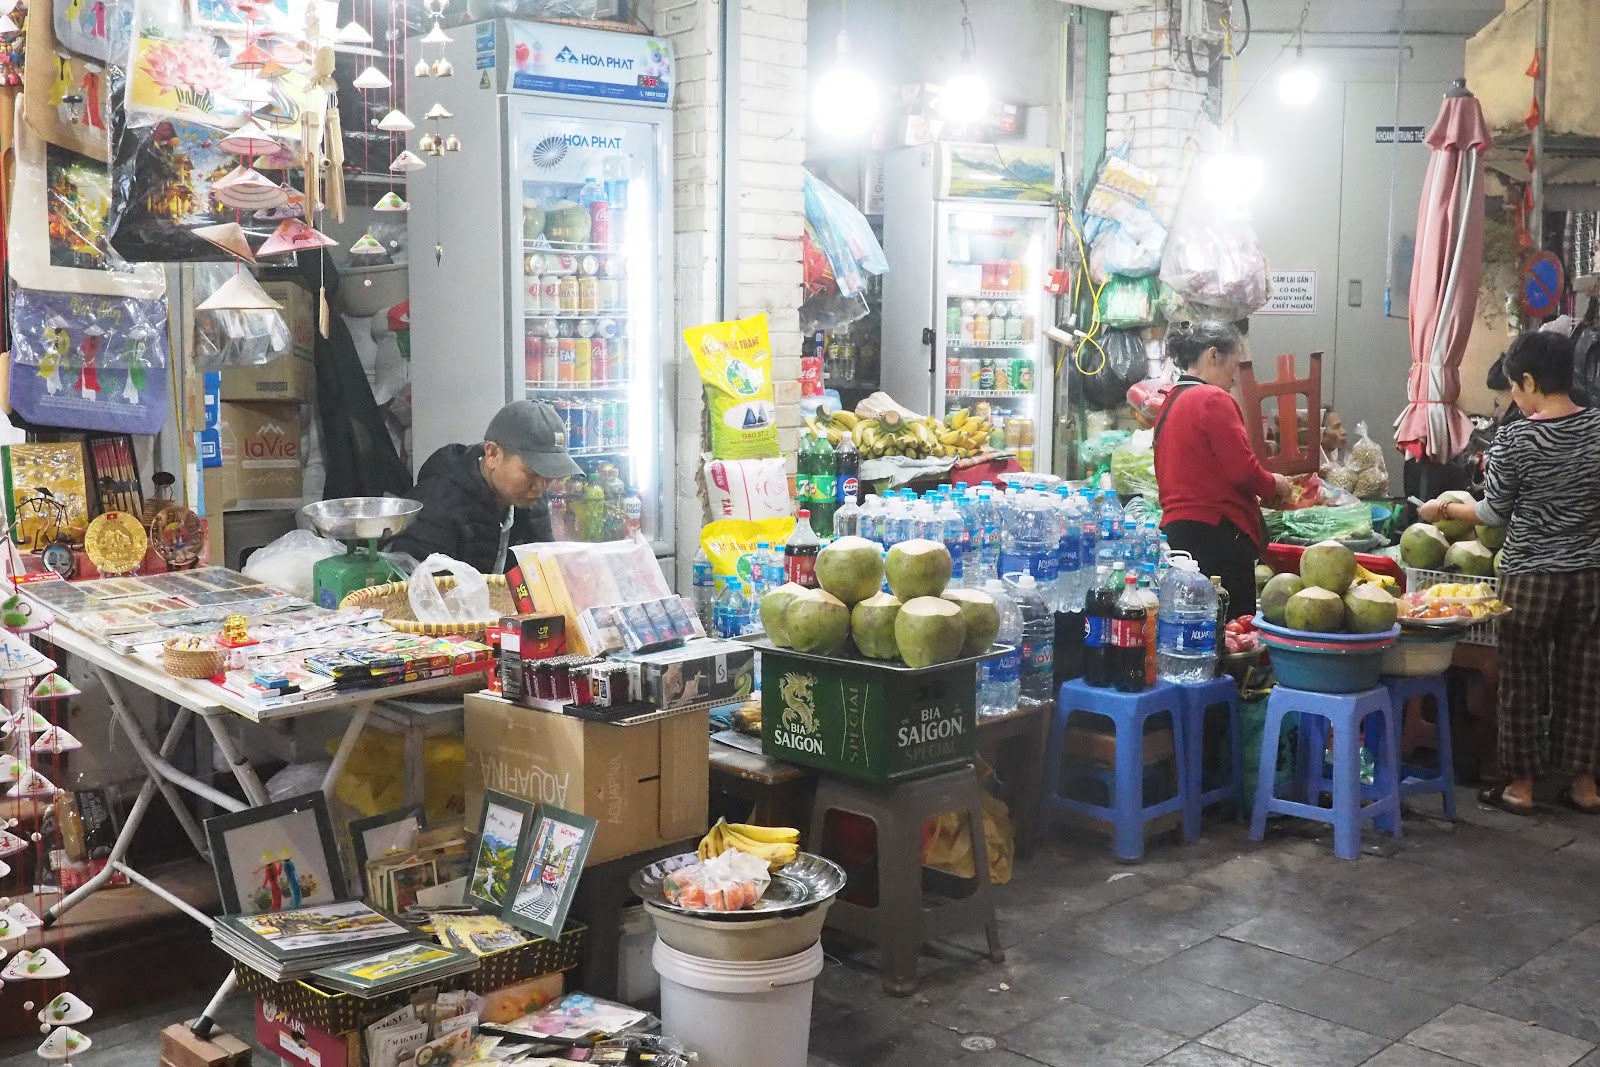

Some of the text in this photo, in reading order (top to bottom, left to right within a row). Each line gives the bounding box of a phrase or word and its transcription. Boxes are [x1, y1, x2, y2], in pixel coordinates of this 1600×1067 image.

[244, 435, 297, 458] laVie
[920, 707, 941, 722] BIA
[790, 723, 806, 735] BIA
[898, 716, 963, 748] SAIGON
[774, 729, 824, 756] SAIGON
[480, 752, 569, 810] AQUAFINA
